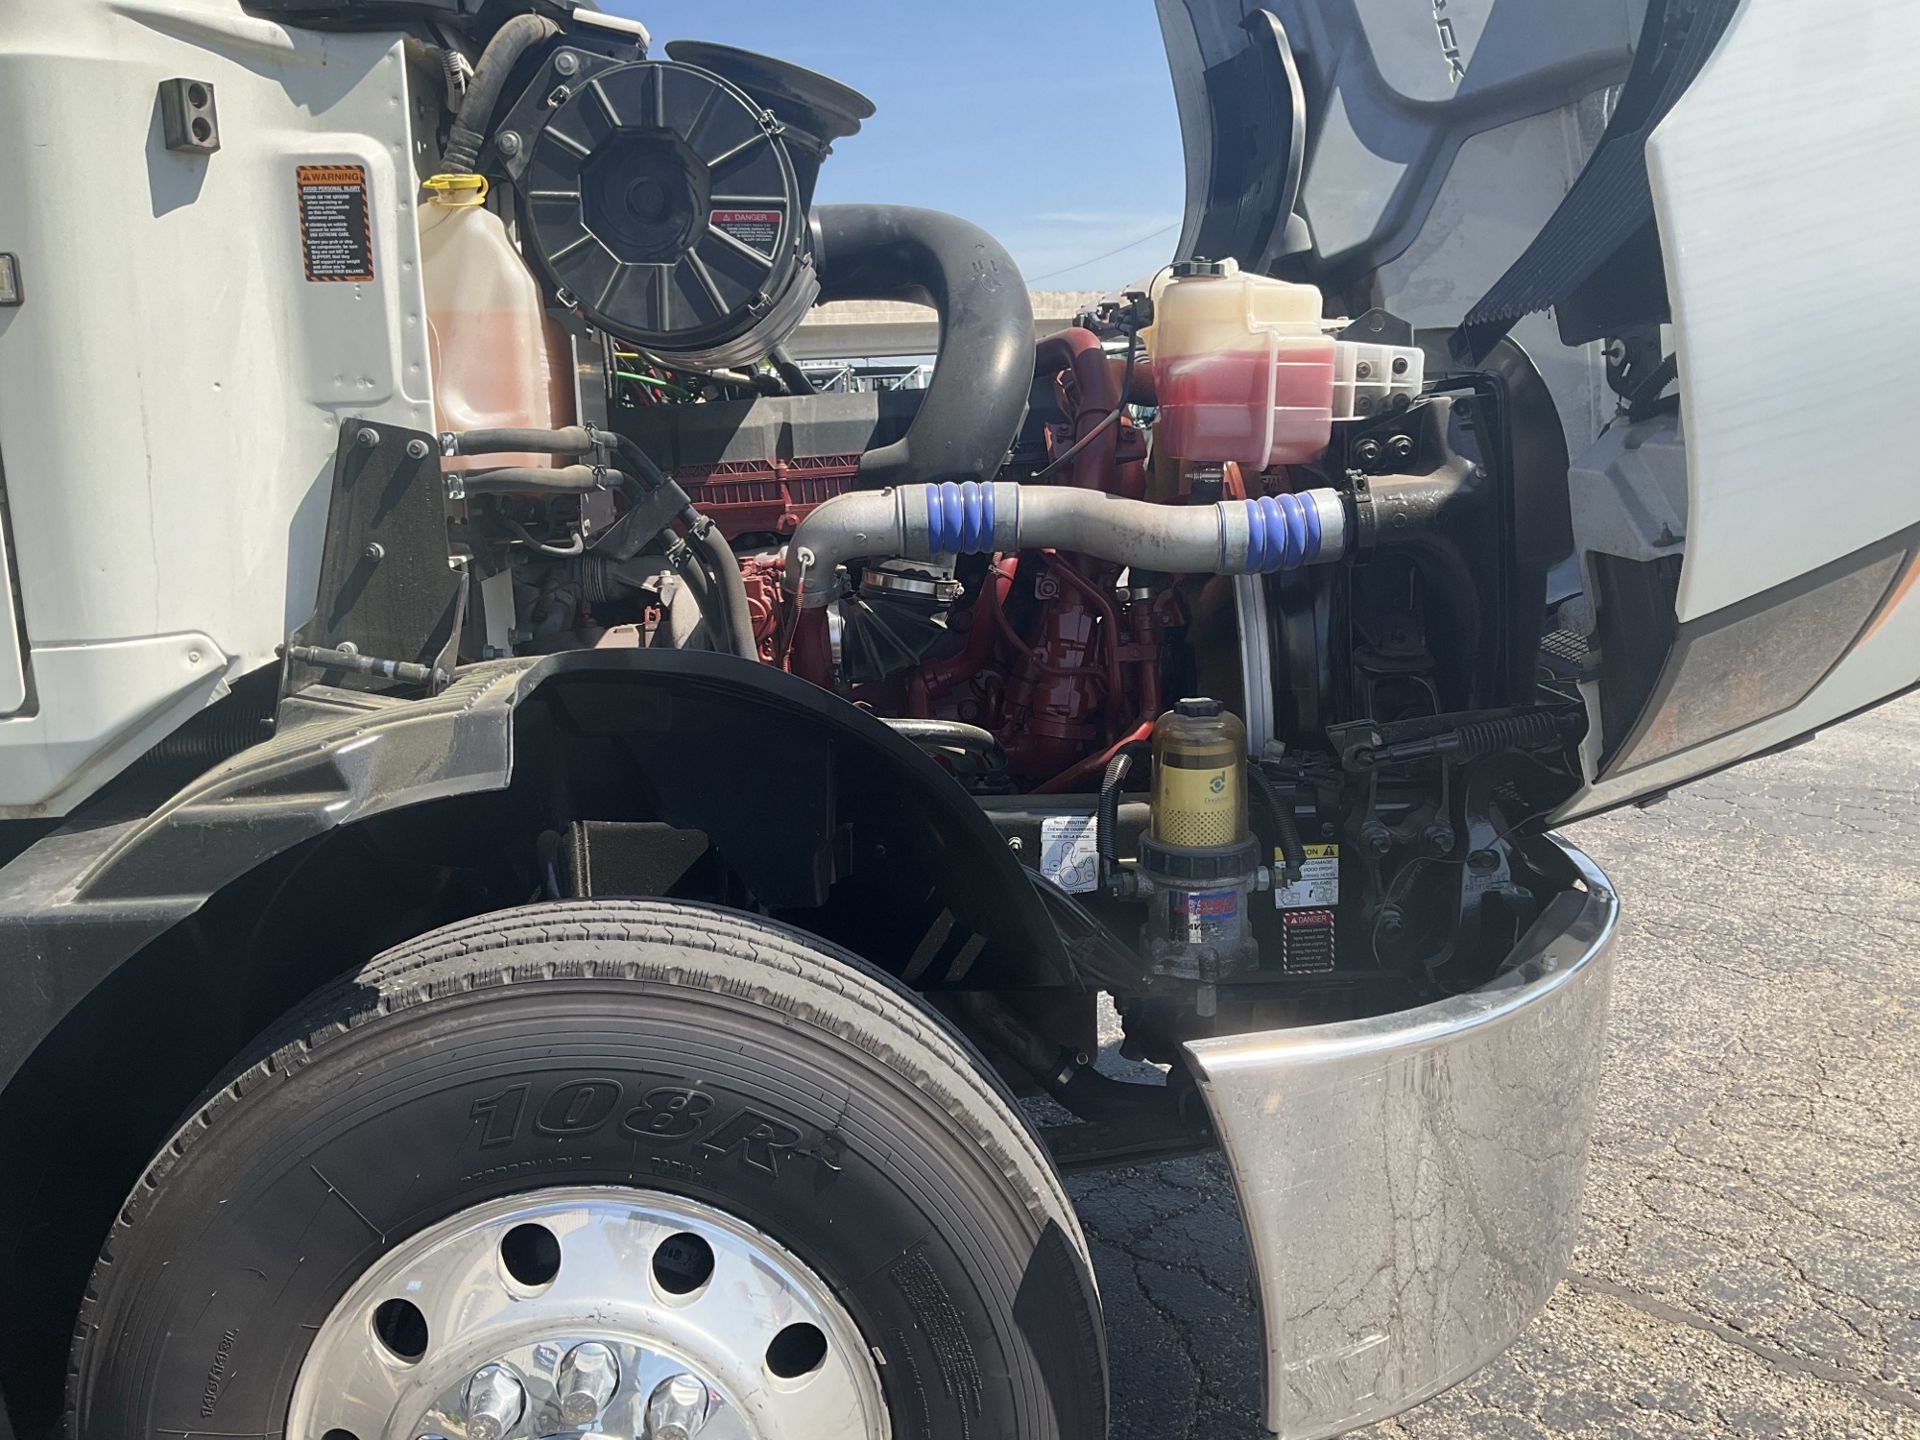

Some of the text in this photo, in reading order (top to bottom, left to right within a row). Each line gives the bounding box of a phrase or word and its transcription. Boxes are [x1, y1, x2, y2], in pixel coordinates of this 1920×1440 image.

[312, 172, 359, 181] WARNING
[1298, 914, 1327, 924] DANGER
[469, 1078, 803, 1177] 108R
